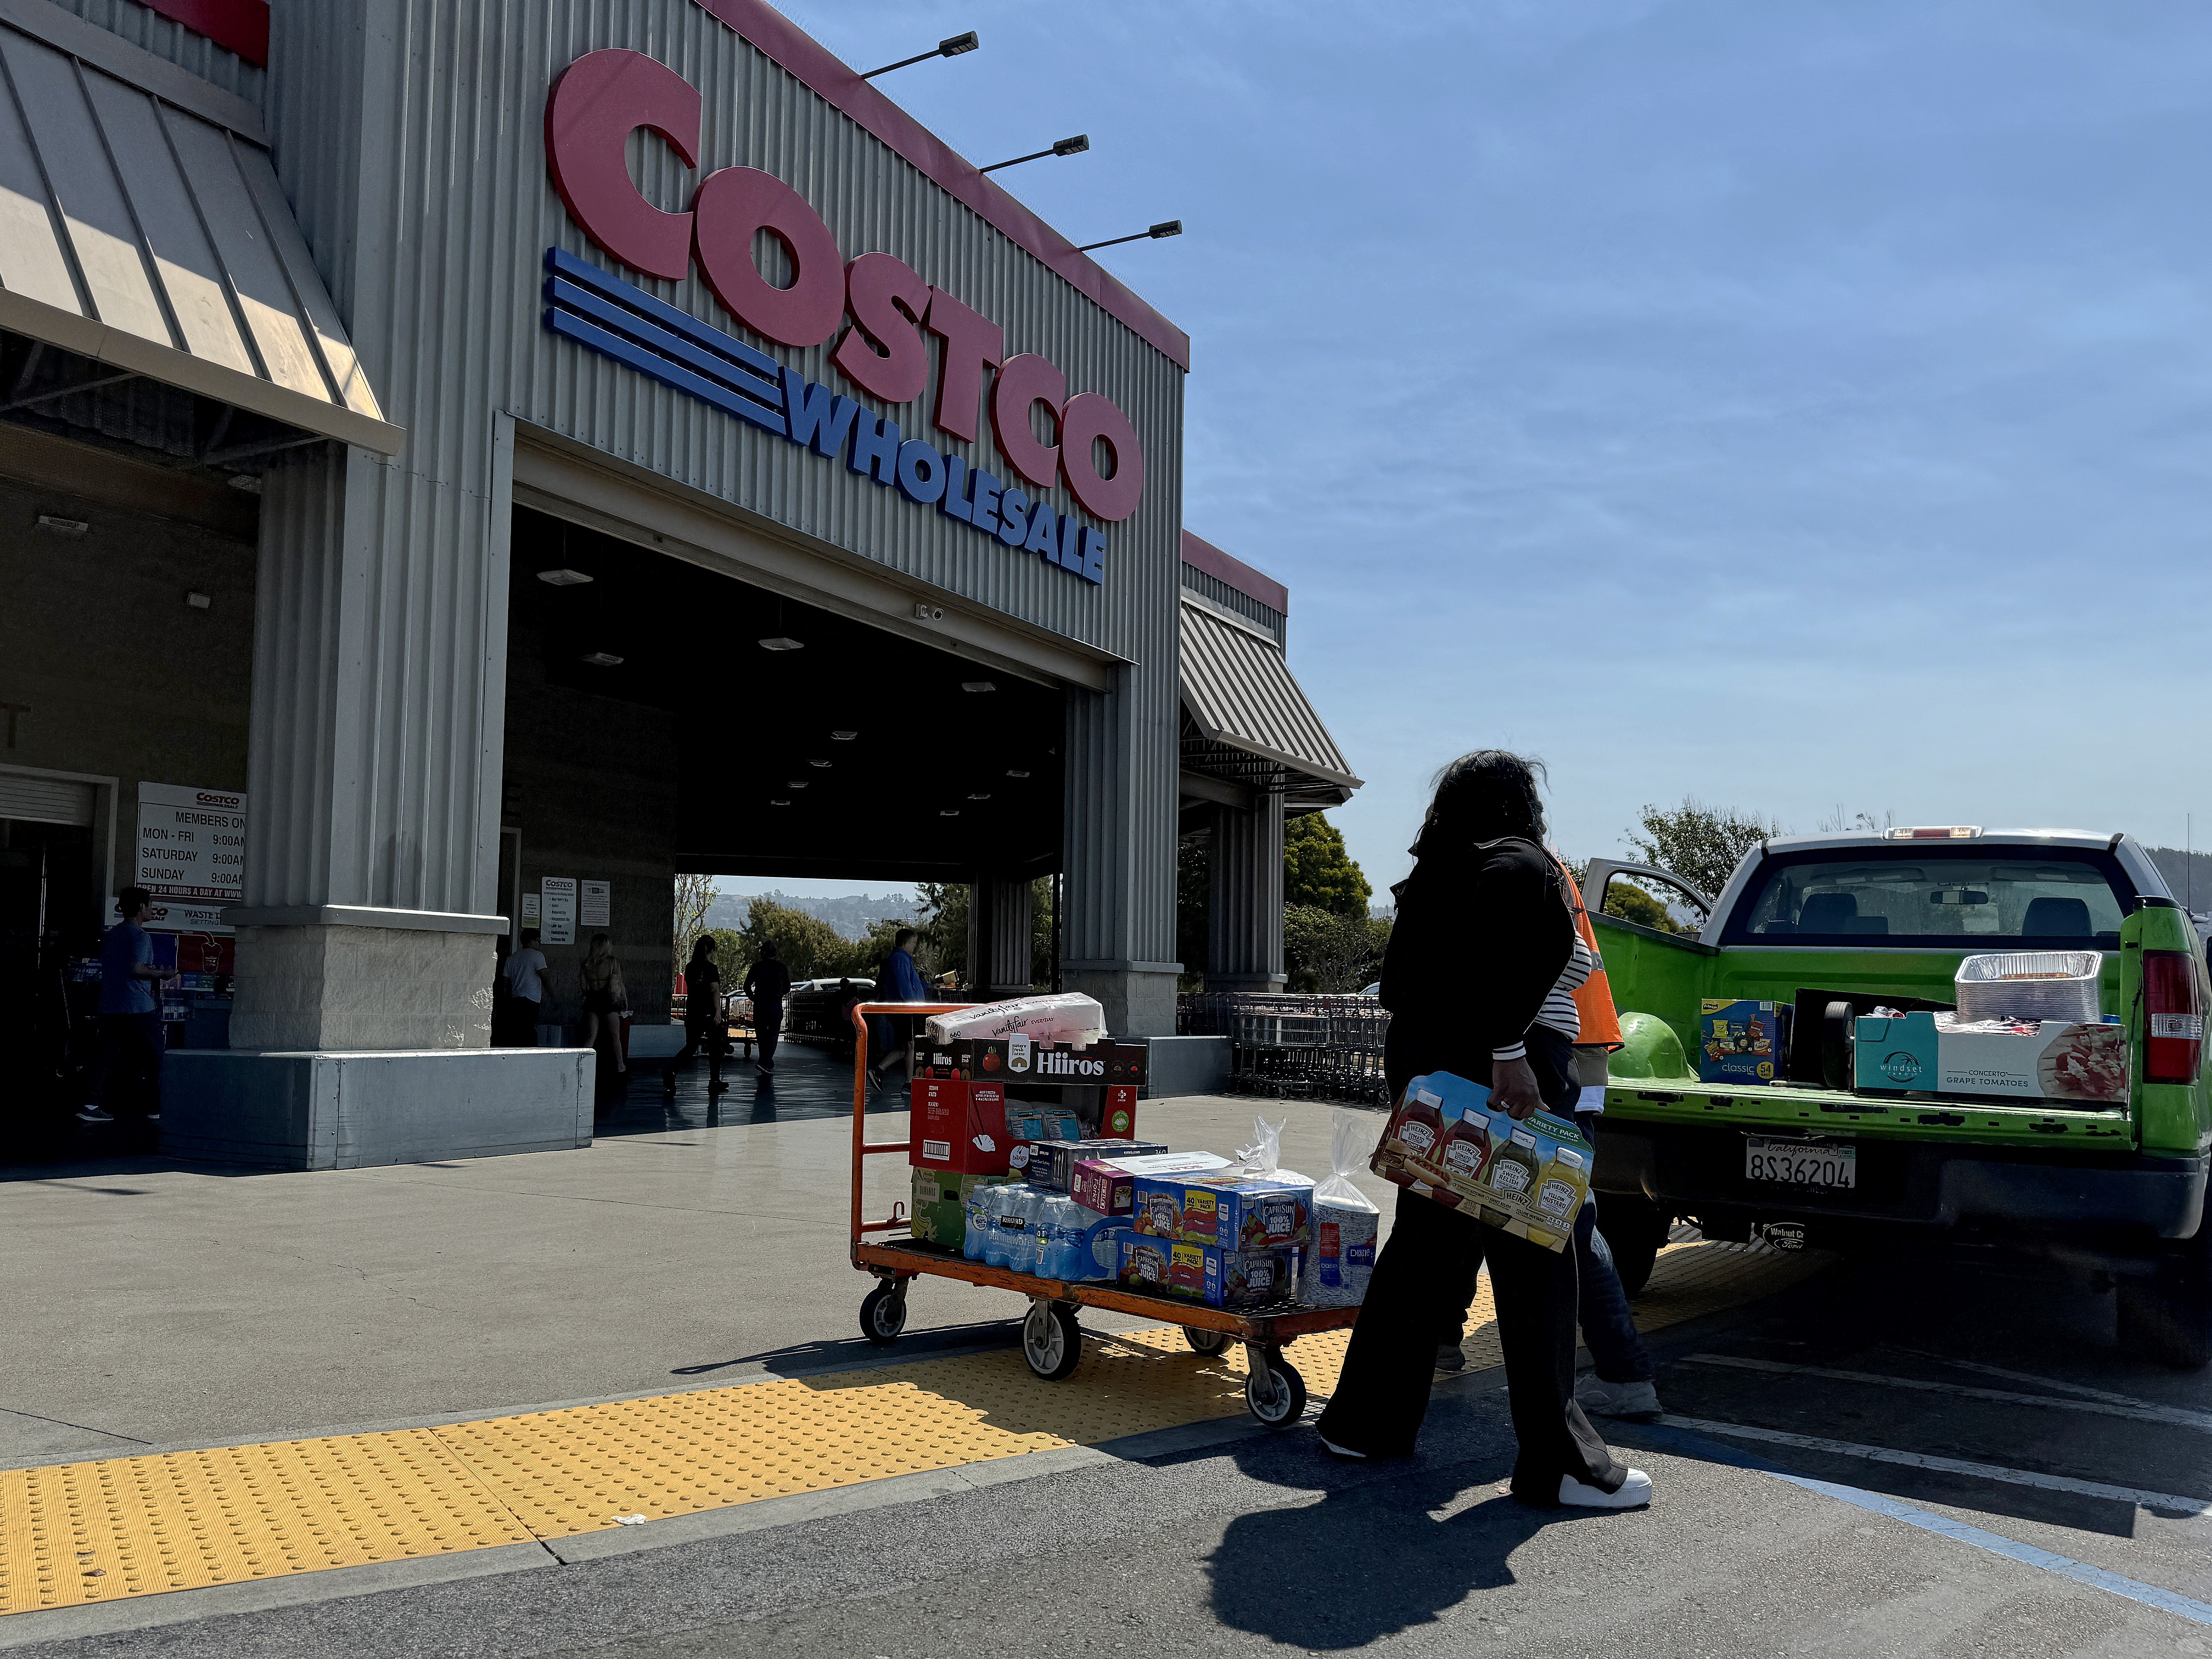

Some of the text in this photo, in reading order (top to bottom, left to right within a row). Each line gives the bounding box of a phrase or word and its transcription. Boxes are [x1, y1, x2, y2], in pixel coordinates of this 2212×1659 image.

[544, 48, 1143, 522] COSTCO
[778, 365, 1106, 585] WHOLESALE
[196, 792, 240, 805] COSTCO
[176, 811, 228, 827] MEMBERS
[143, 828, 168, 839] MON
[178, 831, 194, 842] FRI
[142, 847, 198, 861] SATURDAY
[141, 867, 185, 880] SUNDAY
[158, 885, 167, 893] 24
[169, 886, 191, 895] HOURS
[193, 887, 198, 895] A
[200, 888, 213, 896] DAY
[214, 889, 223, 897] AT
[184, 910, 213, 919] WASTE
[934, 1053, 952, 1065] Hiiros
[1037, 1052, 1104, 1075] Hiiros
[1722, 1063, 1755, 1072] classic
[1761, 1065, 1771, 1073] 54
[1880, 1064, 1922, 1072] windset
[1979, 1078, 2028, 1087] TOMATOES
[1411, 1125, 1429, 1136] HEINZ
[1528, 1117, 1558, 1132] VARIETY
[1559, 1129, 1579, 1140] PACK
[1457, 1145, 1475, 1155] HEINZ
[1768, 1144, 1832, 1157] California
[1502, 1170, 1519, 1180] SWEET
[1505, 1164, 1523, 1175] HEINZ
[1751, 1154, 1850, 1188] 8S36204
[1499, 1175, 1519, 1186] RELISH
[1552, 1184, 1570, 1194] HEINZ
[1506, 1192, 1529, 1206] HEINZ
[1543, 1196, 1567, 1209] MUSTARD
[1549, 1192, 1565, 1202] YELLOW
[1155, 1213, 1169, 1222] 100%
[1270, 1215, 1289, 1224] 100%
[1153, 1219, 1170, 1231] JUICE
[1266, 1223, 1291, 1233] JUICE
[1771, 1228, 1795, 1238] Walnut
[1782, 1240, 1803, 1249] Ford
[1141, 1263, 1154, 1273] 100%
[1251, 1269, 1269, 1278] 100%
[1138, 1269, 1156, 1282] JUICE
[1247, 1276, 1271, 1288] JUICE
